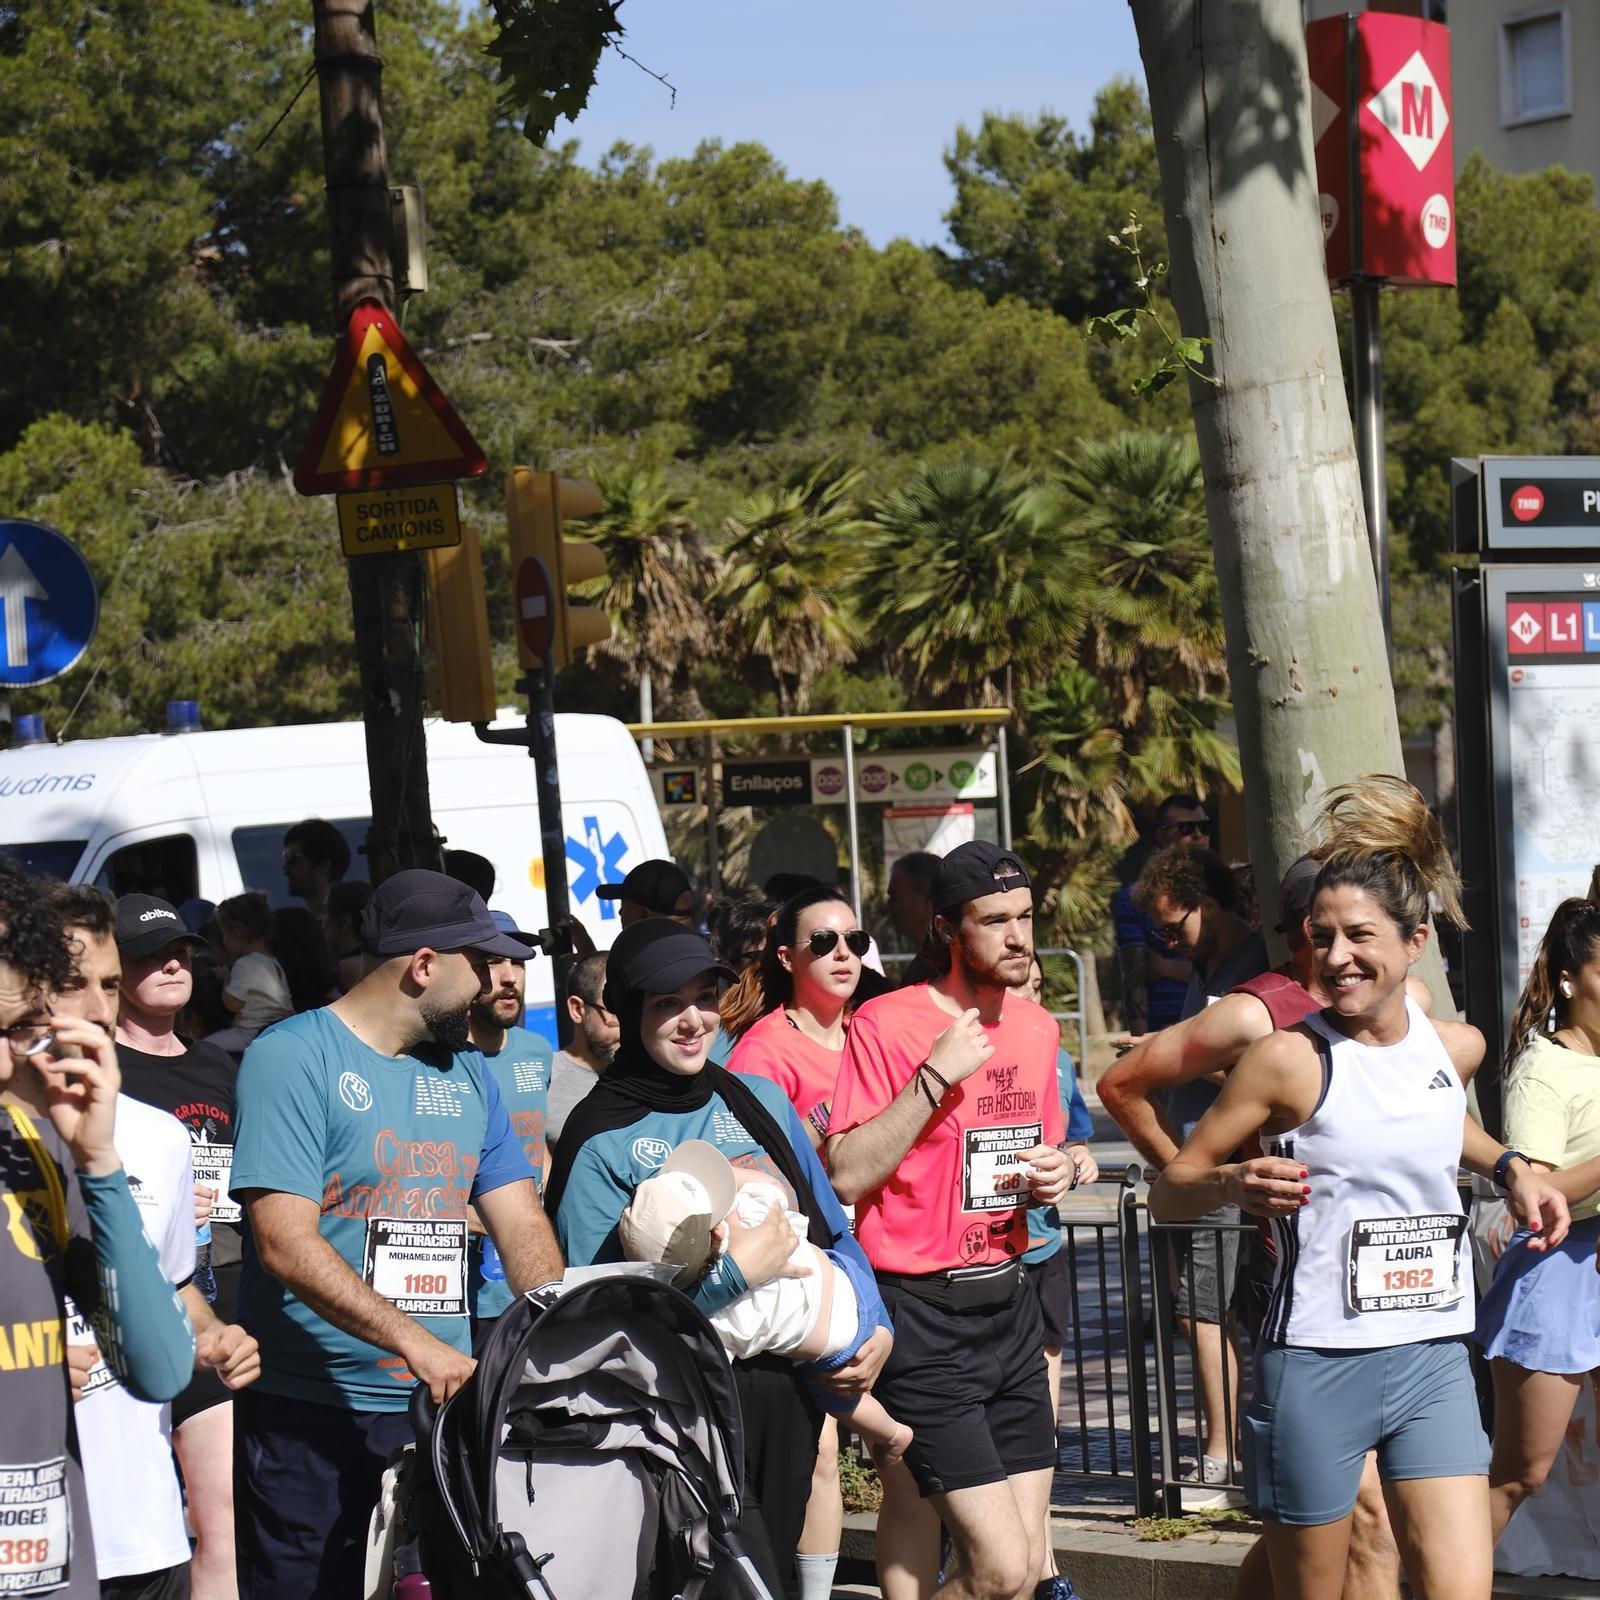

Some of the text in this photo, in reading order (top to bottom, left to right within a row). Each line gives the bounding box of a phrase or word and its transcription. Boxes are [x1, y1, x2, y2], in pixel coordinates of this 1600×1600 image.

[1401, 81, 1433, 140] M
[1429, 213, 1448, 232] TMB
[356, 498, 440, 520] SORTIDA
[1518, 498, 1540, 511] TMB
[356, 518, 445, 543] CAMIONS
[1520, 621, 1532, 635] M
[1551, 612, 1577, 641] L1
[731, 775, 803, 792] Enllaços
[174, 1103, 230, 1125] GRATION
[977, 1095, 994, 1117] FER
[971, 1129, 1014, 1143] PRIMERA
[977, 1138, 1035, 1153] ANTIRACISTA
[992, 1172, 1020, 1192] 786
[972, 1198, 985, 1209] DE
[378, 1221, 432, 1235] PRIMERA
[1358, 1216, 1459, 1234] PRIMERA CURSA
[387, 1234, 460, 1248] ANTIRACISTA
[1368, 1228, 1448, 1245] ANTIRACISTA
[388, 1251, 431, 1262] MOHAMED
[1385, 1245, 1433, 1262] LAURA
[404, 1274, 447, 1295] 1180
[1383, 1268, 1434, 1291] 1362
[396, 1300, 460, 1312] BARCELONA
[1361, 1298, 1379, 1311] DE
